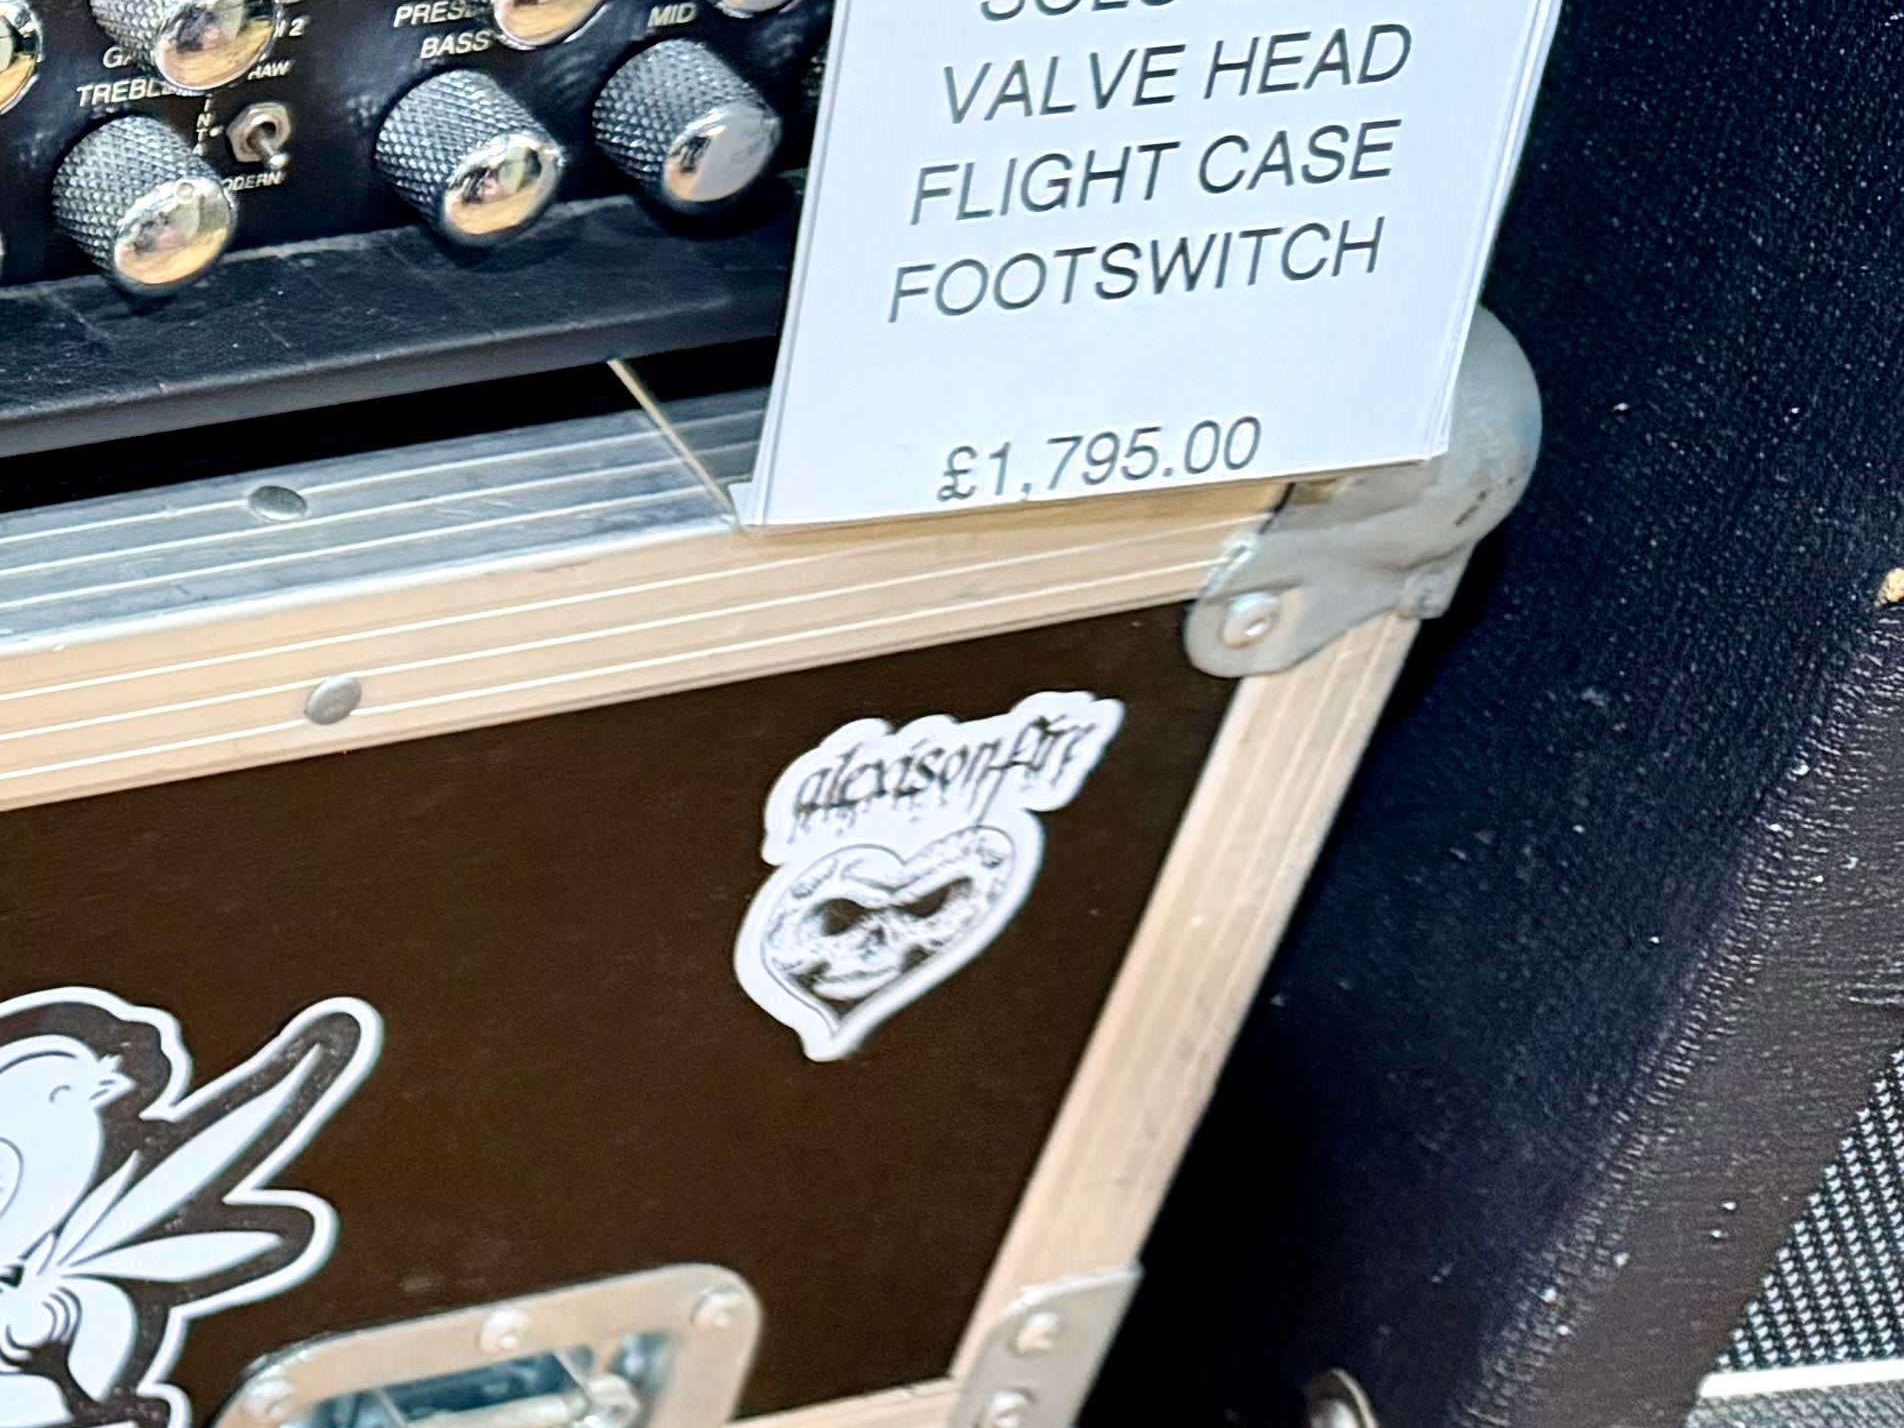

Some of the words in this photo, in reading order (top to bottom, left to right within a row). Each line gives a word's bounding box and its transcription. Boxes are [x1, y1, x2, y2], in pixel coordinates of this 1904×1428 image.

[420, 29, 494, 60] BASS
[647, 1, 697, 28] MID
[944, 43, 1185, 124] VALVE
[1204, 23, 1412, 100] HEAD
[910, 141, 1180, 225] FLIGHT
[1199, 119, 1401, 194] CASE
[887, 216, 1386, 323] FOOTSWITCH
[936, 415, 1261, 503] £1,795.00
